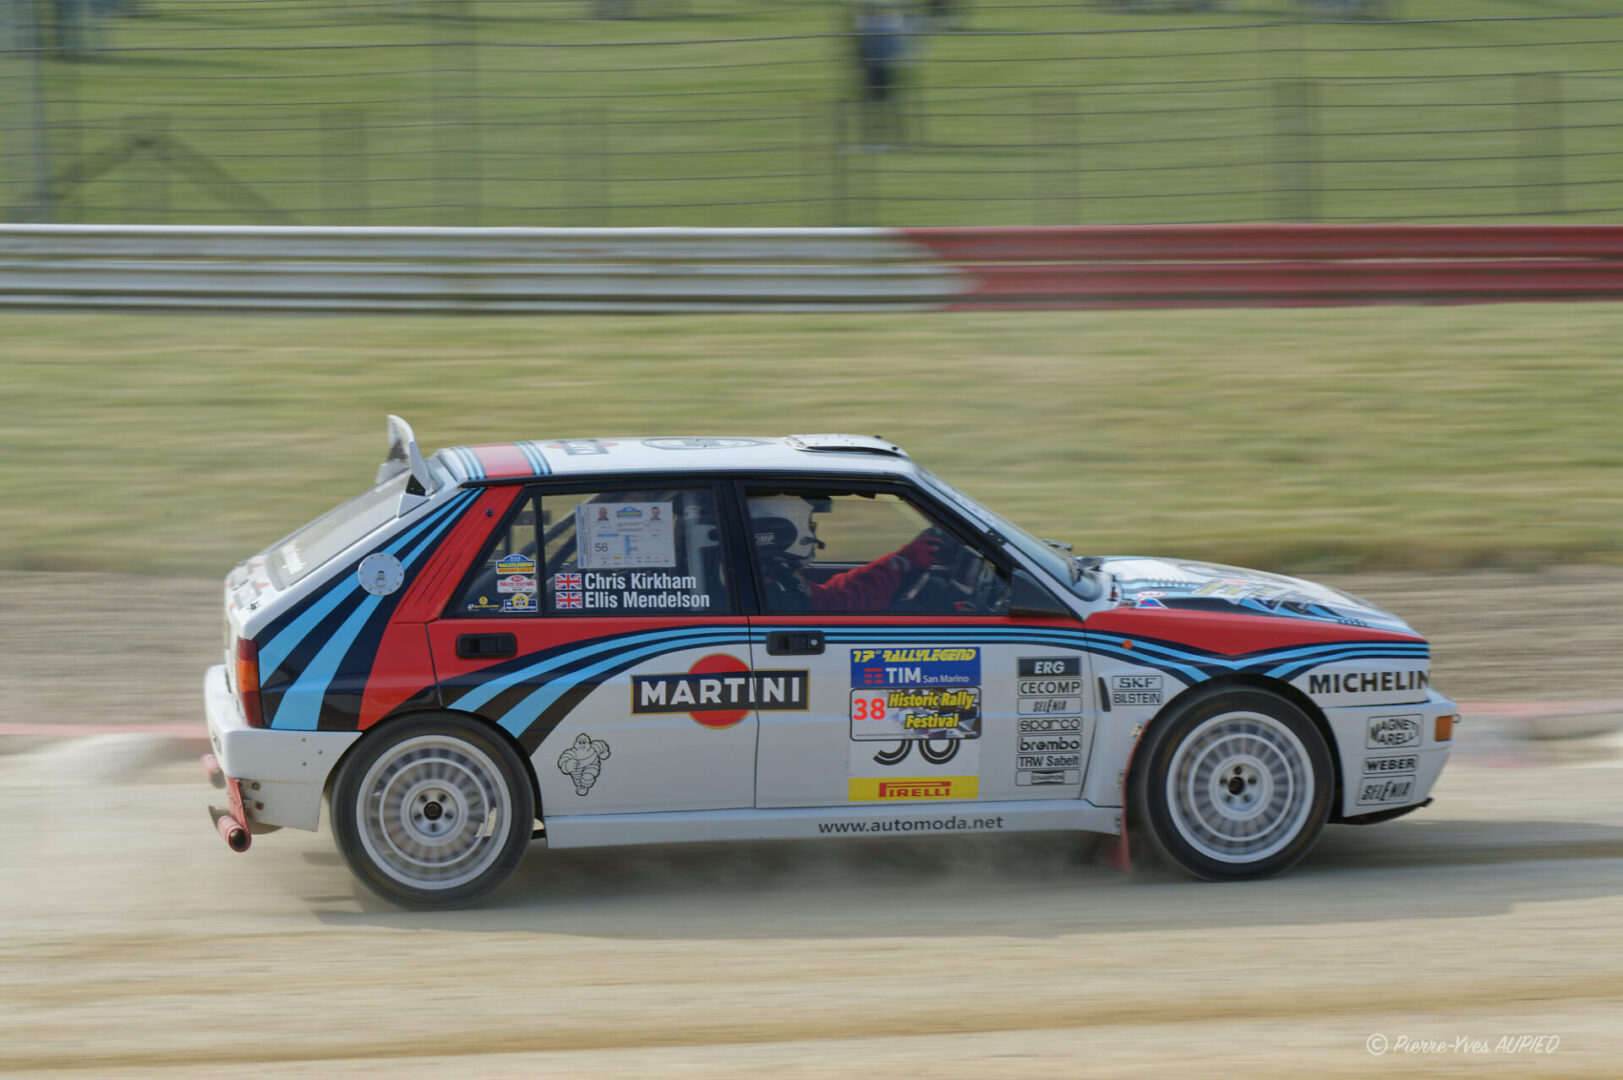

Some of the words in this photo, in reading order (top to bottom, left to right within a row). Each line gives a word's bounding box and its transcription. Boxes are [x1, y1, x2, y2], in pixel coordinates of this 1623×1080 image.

[594, 543, 609, 553] 56
[584, 573, 626, 589] Chris
[631, 573, 697, 589] Kirkham
[585, 591, 618, 608] Ellis
[623, 591, 710, 608] Mendelson
[882, 648, 977, 662] RALLYLEGEND
[885, 667, 921, 683] TIM
[922, 675, 939, 683] San
[940, 674, 970, 683] Marino
[1034, 661, 1066, 674] ERG
[1020, 681, 1081, 694] CECOMP
[1119, 677, 1157, 689] SKF
[1309, 670, 1430, 694] MICHELIN
[641, 677, 800, 706] MARTINI
[1114, 693, 1161, 704] BILSTEIN
[888, 691, 940, 707] Historic
[940, 689, 976, 710] Rally
[852, 698, 886, 720] 38
[904, 712, 960, 729] Festival
[1020, 718, 1081, 731] sparco
[1020, 737, 1080, 751] brembo
[1019, 756, 1044, 767] TRW
[1046, 755, 1079, 767] Sabelt
[1366, 759, 1416, 771] WEBER
[879, 781, 952, 797] PIRELLI
[818, 816, 1004, 834] www.automoda.net
